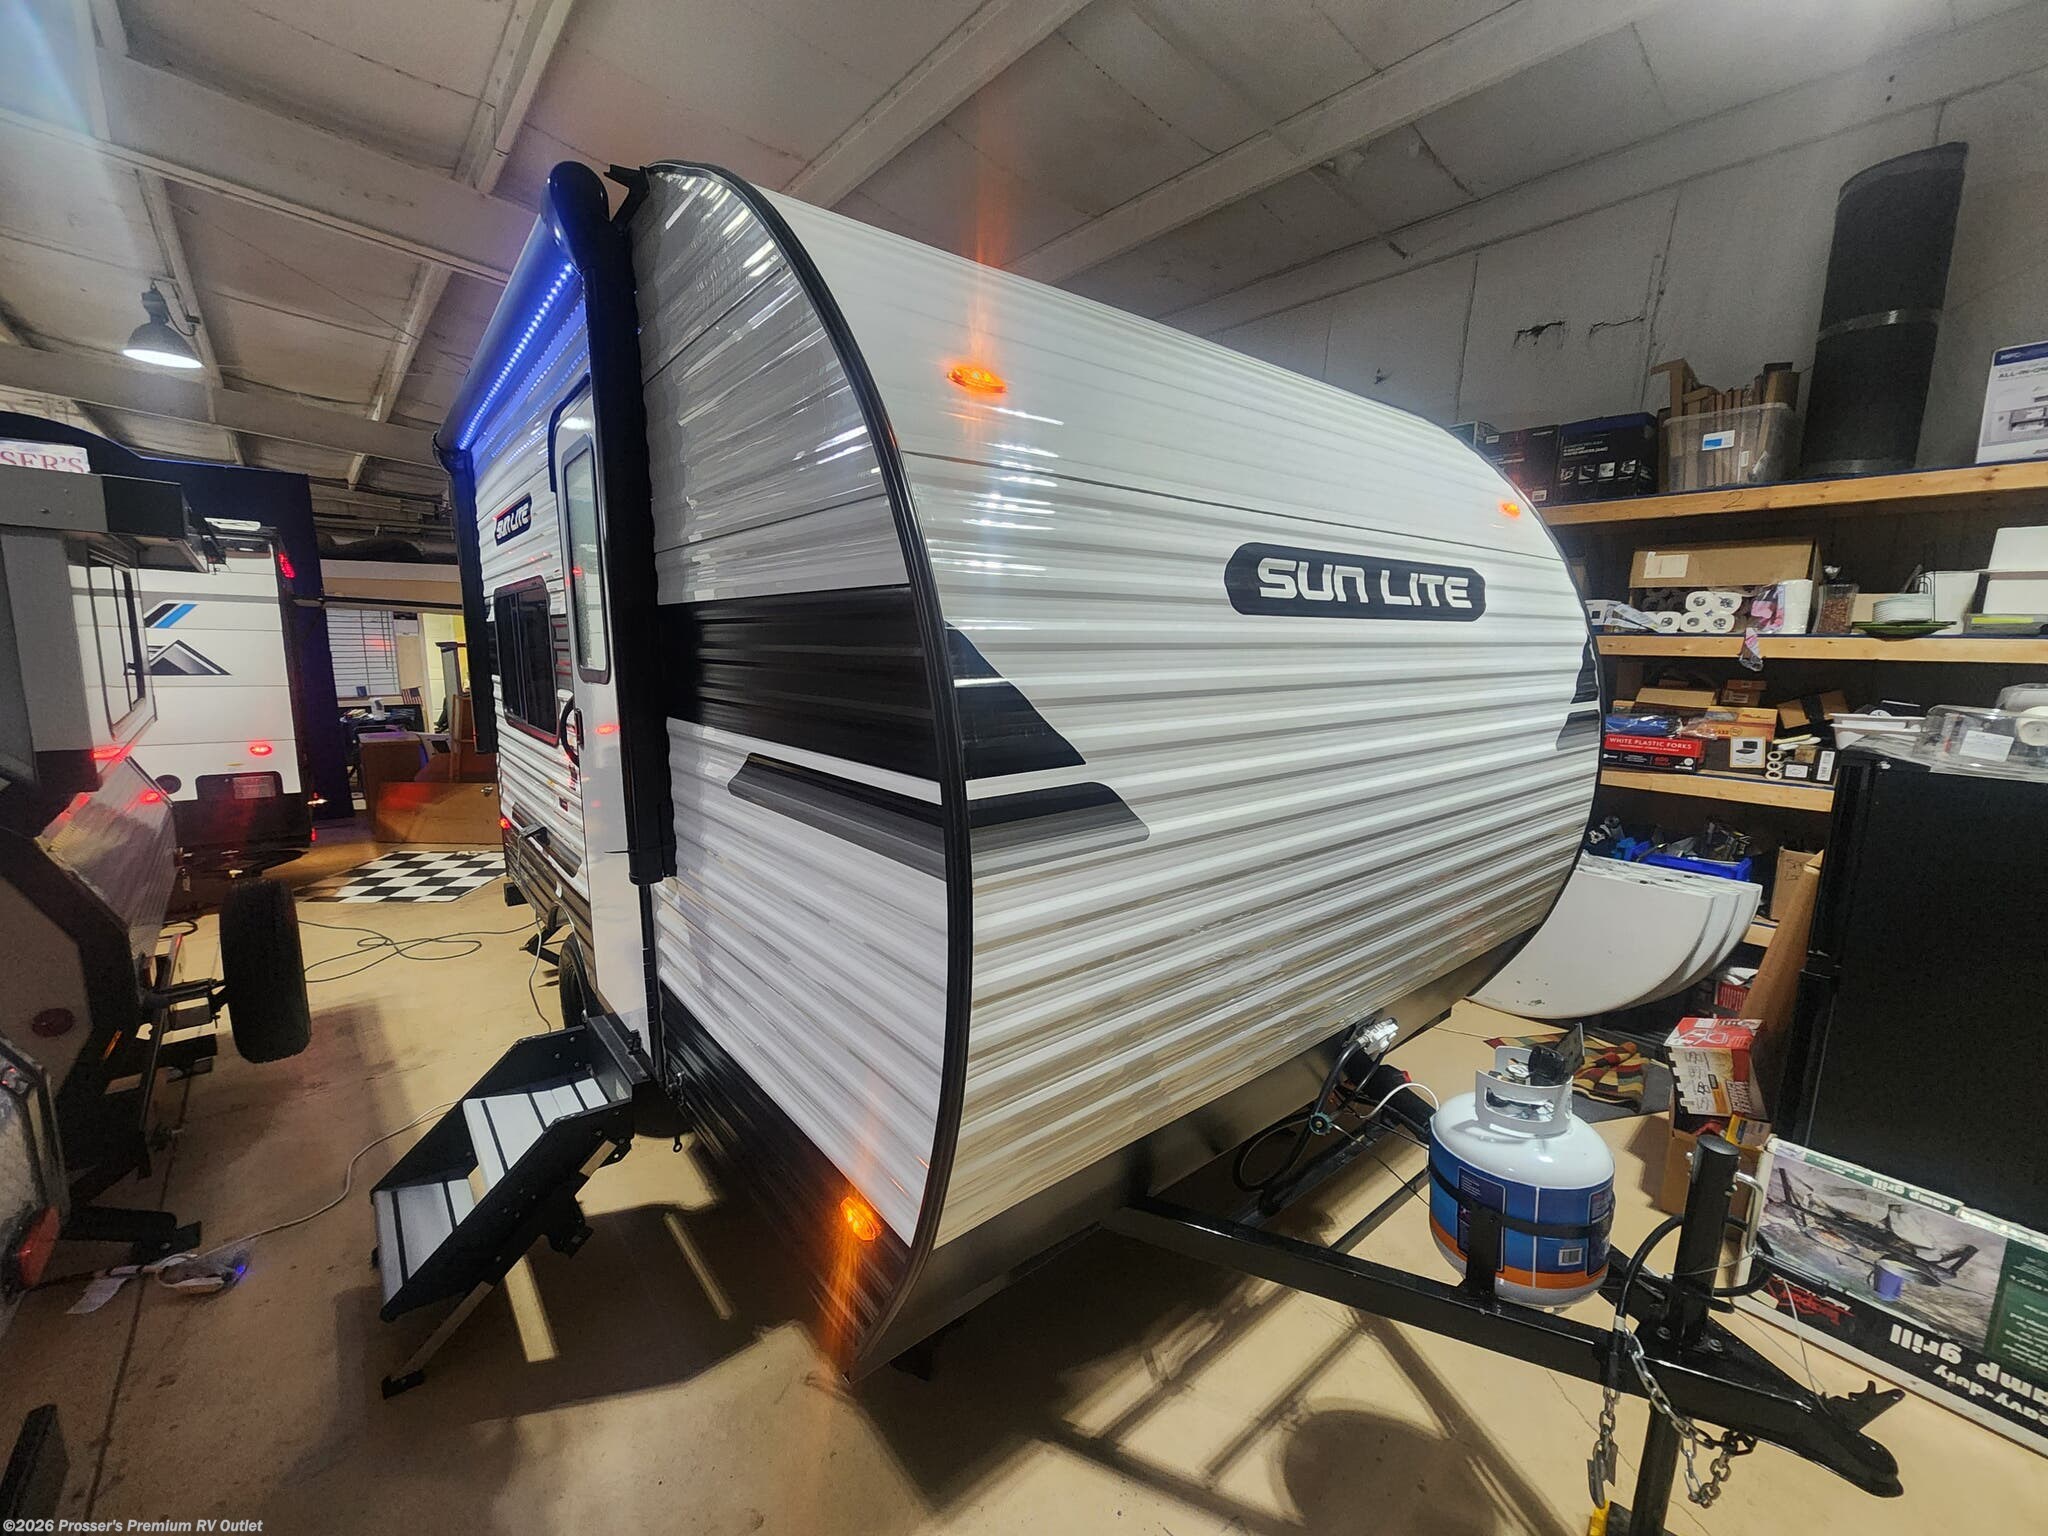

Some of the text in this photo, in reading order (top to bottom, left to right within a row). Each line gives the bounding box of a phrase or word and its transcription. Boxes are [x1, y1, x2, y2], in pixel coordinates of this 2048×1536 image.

[1722, 491, 1746, 509] 2
[496, 502, 529, 539] SUN LITE
[1257, 557, 1473, 609] SUN LITE
[1609, 737, 1633, 745] WHITE
[1634, 739, 1665, 747] PLASTIC
[1666, 741, 1693, 750] FORKS
[1889, 1323, 1962, 1365] grill
